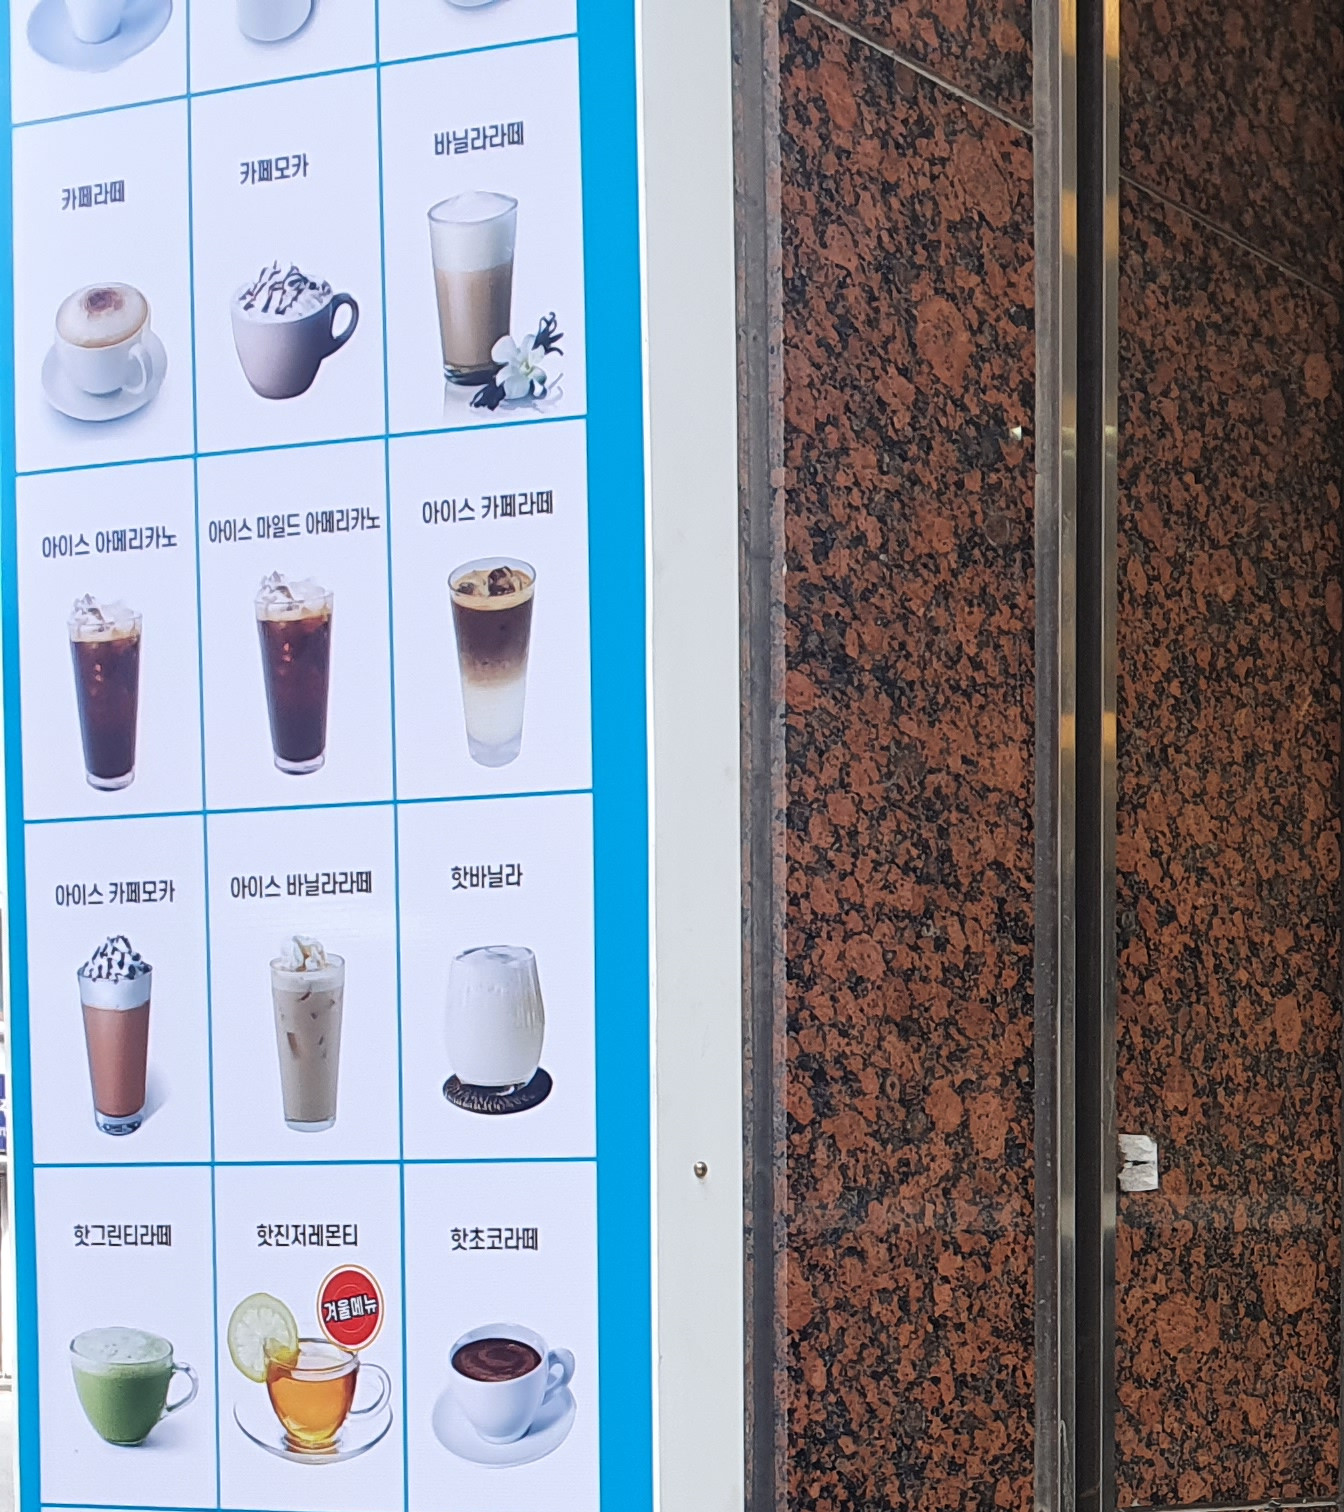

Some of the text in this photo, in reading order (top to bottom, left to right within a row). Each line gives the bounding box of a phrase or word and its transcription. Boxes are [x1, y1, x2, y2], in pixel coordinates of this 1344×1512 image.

[435, 121, 524, 155] 바닐라라떼
[241, 154, 308, 184] 카페모카
[62, 180, 125, 210] 카페라떼
[423, 490, 553, 524] 아이스 카페라떼
[209, 505, 381, 543] 아이스 마일드 아메리카노
[43, 526, 177, 558] 아이스 아메리카노
[231, 871, 372, 899] 아이스 바닐라라떼
[451, 864, 523, 890] 핫바닐라
[56, 880, 175, 906] 아이스 카페모카
[74, 1225, 171, 1246] 핫그린티라떼
[257, 1224, 357, 1246] 핫진저레몬티
[451, 1227, 538, 1250] 핫초코라떼
[323, 1294, 378, 1323] 겨울메뉴
